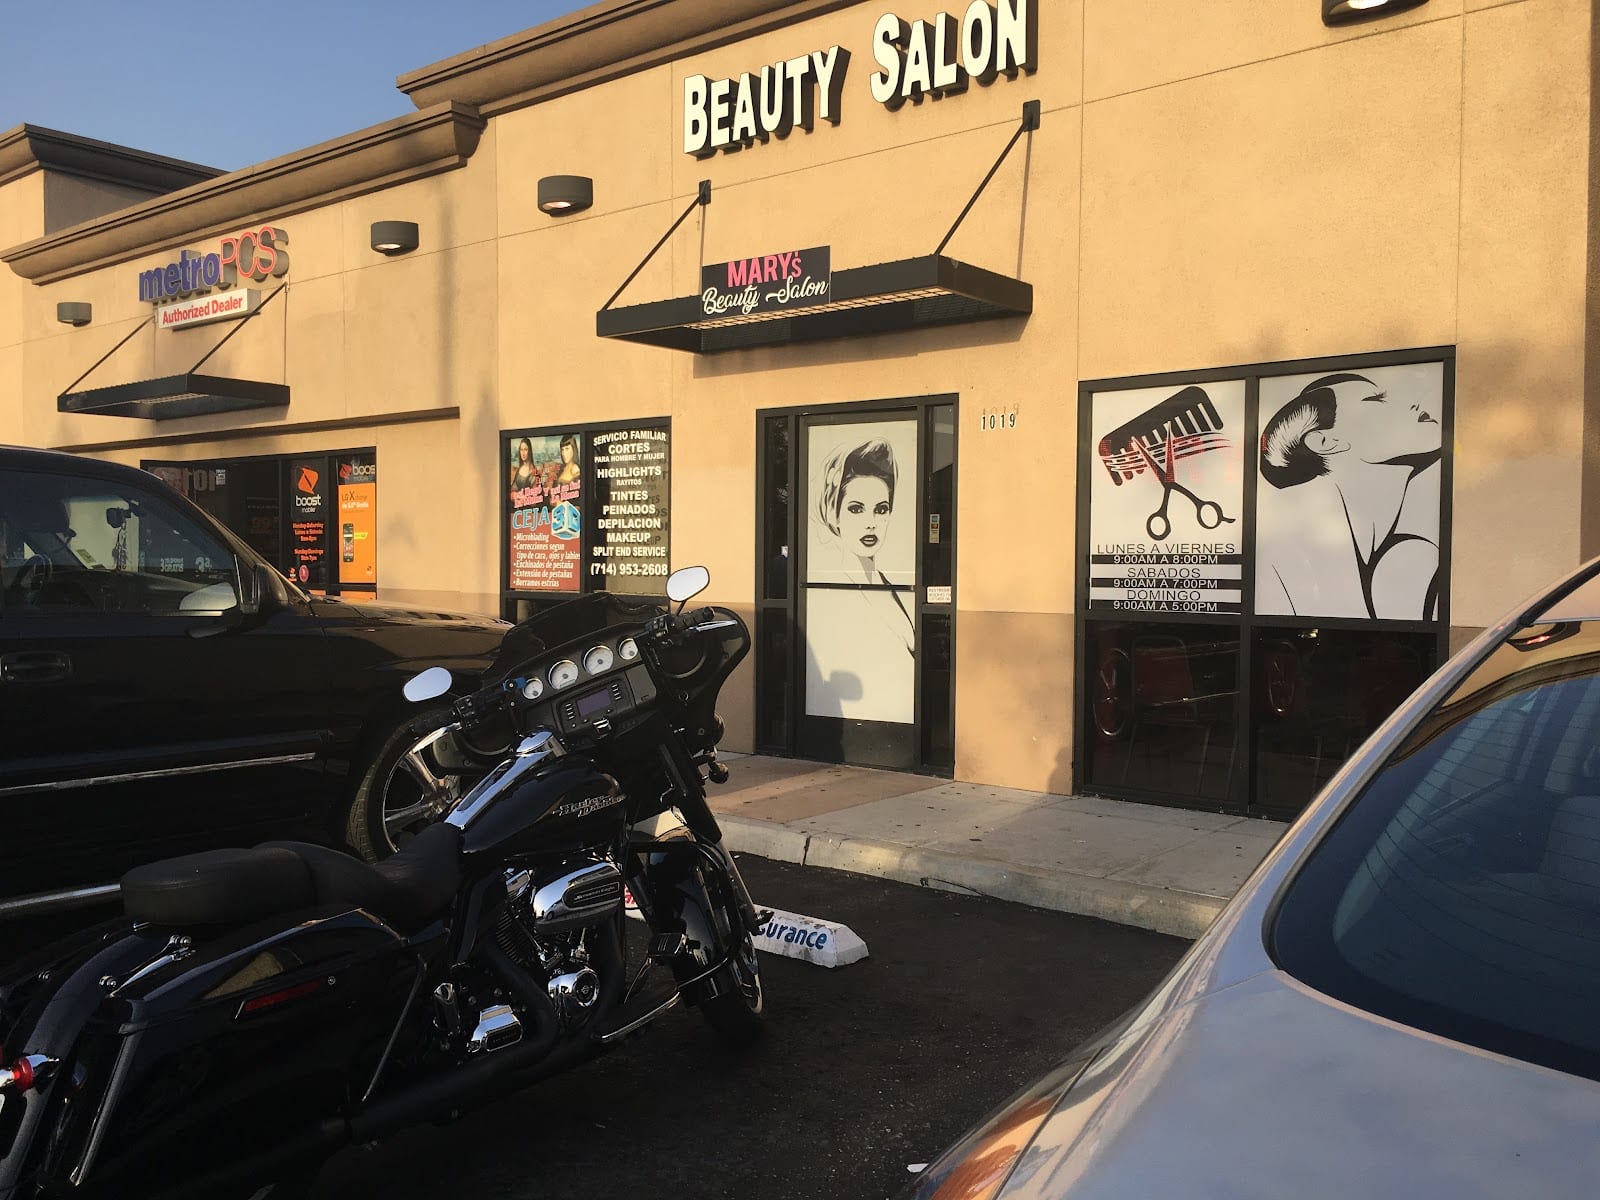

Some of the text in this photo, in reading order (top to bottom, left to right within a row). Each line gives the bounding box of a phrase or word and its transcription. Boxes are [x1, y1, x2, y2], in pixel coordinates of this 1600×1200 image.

[684, 0, 1026, 154] BEAUTY SALON
[139, 226, 277, 301] metroPCS
[702, 275, 829, 314] Beauty Salon
[162, 296, 243, 325] Authorized Dealer
[981, 413, 1016, 431] 1019
[593, 430, 666, 446] SERVICIO FAMILIAR
[608, 442, 651, 454] CORTES
[594, 455, 610, 463] PARA
[611, 454, 637, 462] HOMBRE
[643, 452, 665, 460] MUJER
[597, 466, 662, 478] HIGHLIGHTS
[295, 494, 321, 507] boost
[610, 490, 649, 501] TINTES
[603, 504, 656, 515] PEINADOS
[512, 506, 550, 531] CEJA
[598, 518, 661, 529] DEPILACION
[516, 533, 549, 543] Microblading
[606, 532, 651, 543] MAKEUP
[516, 542, 548, 550] Correcciones
[593, 546, 666, 557] SPLIT END SERVICE
[1097, 543, 1235, 554] LUNES A VIERNES
[528, 551, 534, 559] de
[1113, 555, 1218, 564] 9:00AM A 8:00PM
[516, 560, 545, 569] Enchinados
[546, 561, 552, 569] de
[590, 562, 668, 576] (714) 953-2608
[542, 570, 548, 578] de
[1127, 568, 1201, 578] SABADOS
[516, 578, 541, 587] Borramos
[1113, 579, 1218, 589] 9:00AM A 7:00PM
[1127, 590, 1201, 601] DOMINGO
[1113, 601, 1218, 612] 9:00AM A 5:00PM
